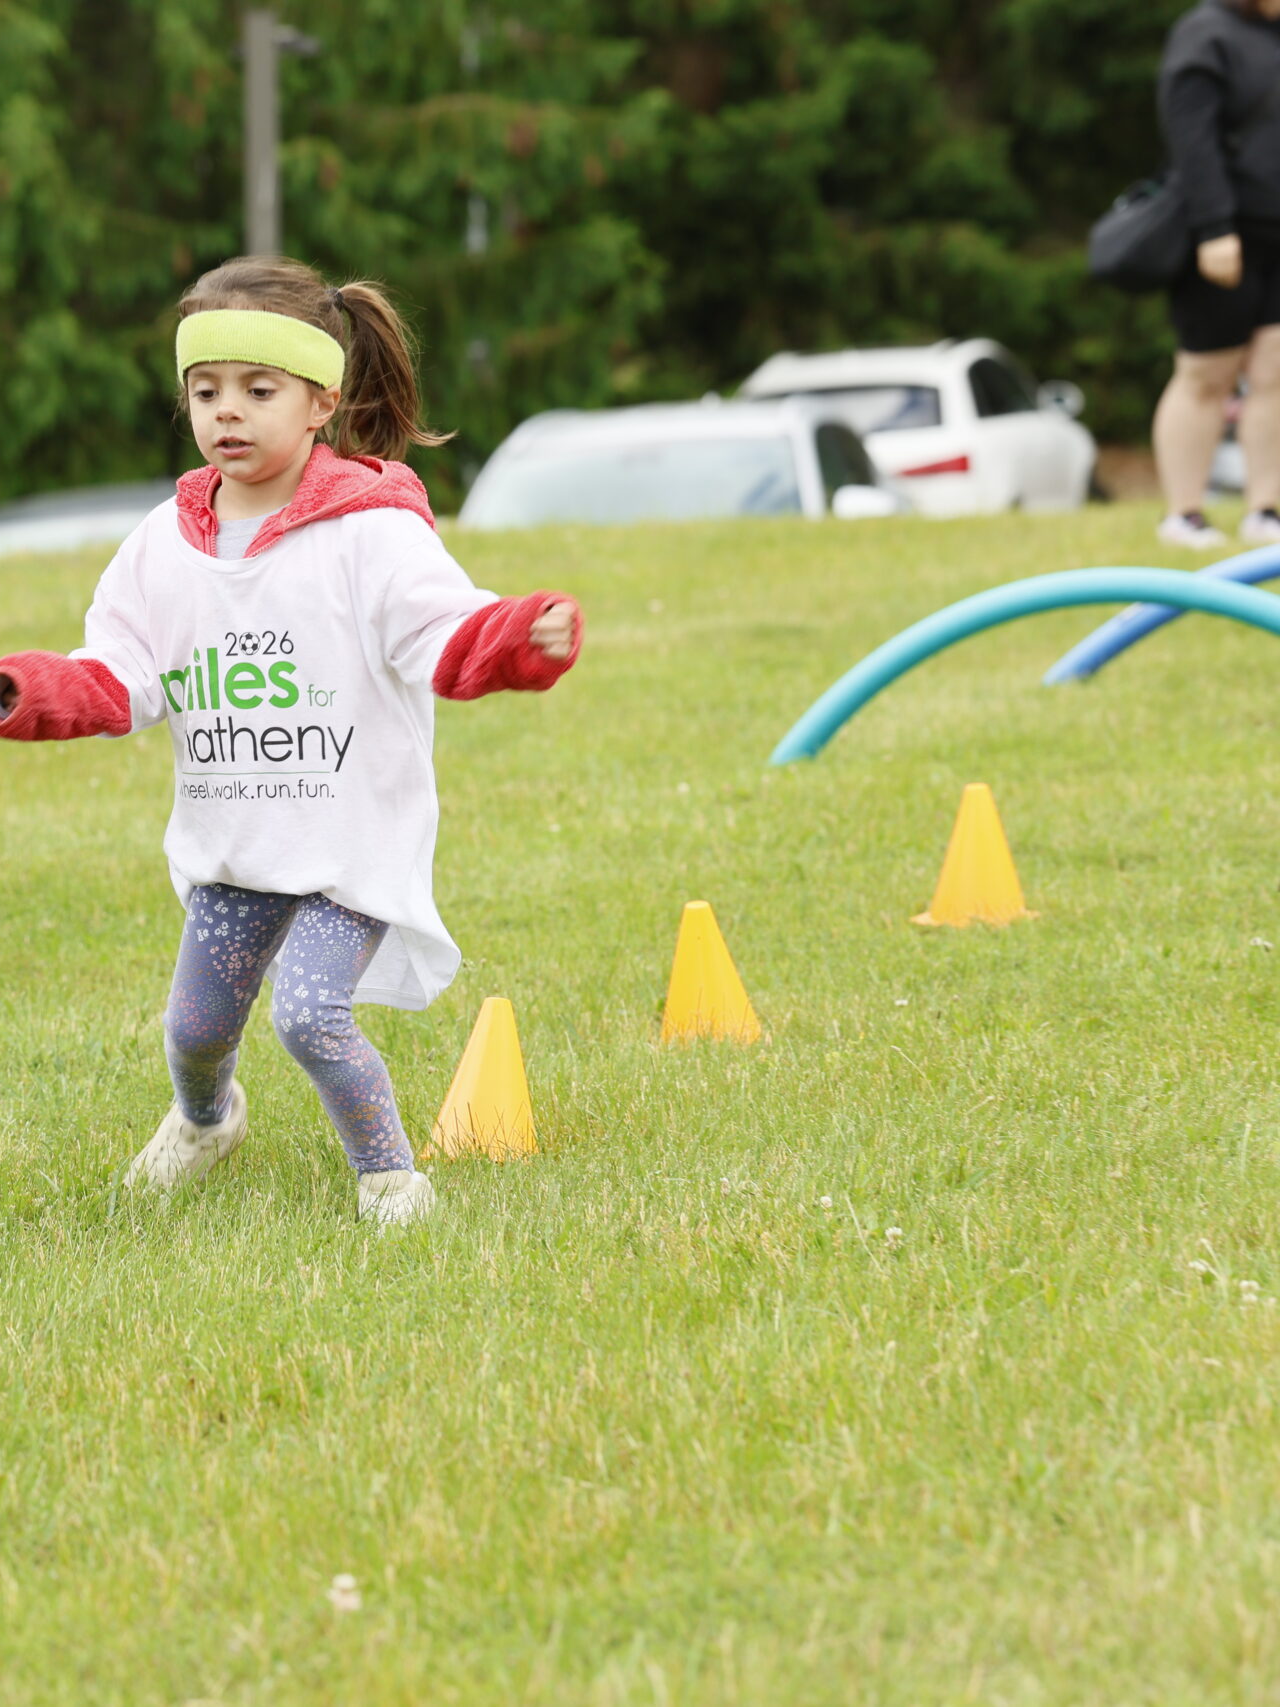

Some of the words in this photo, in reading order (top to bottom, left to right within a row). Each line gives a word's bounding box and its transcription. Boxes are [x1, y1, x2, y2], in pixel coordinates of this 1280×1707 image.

[224, 630, 295, 656] 2026
[307, 684, 337, 707] for
[186, 716, 355, 773] atheny
